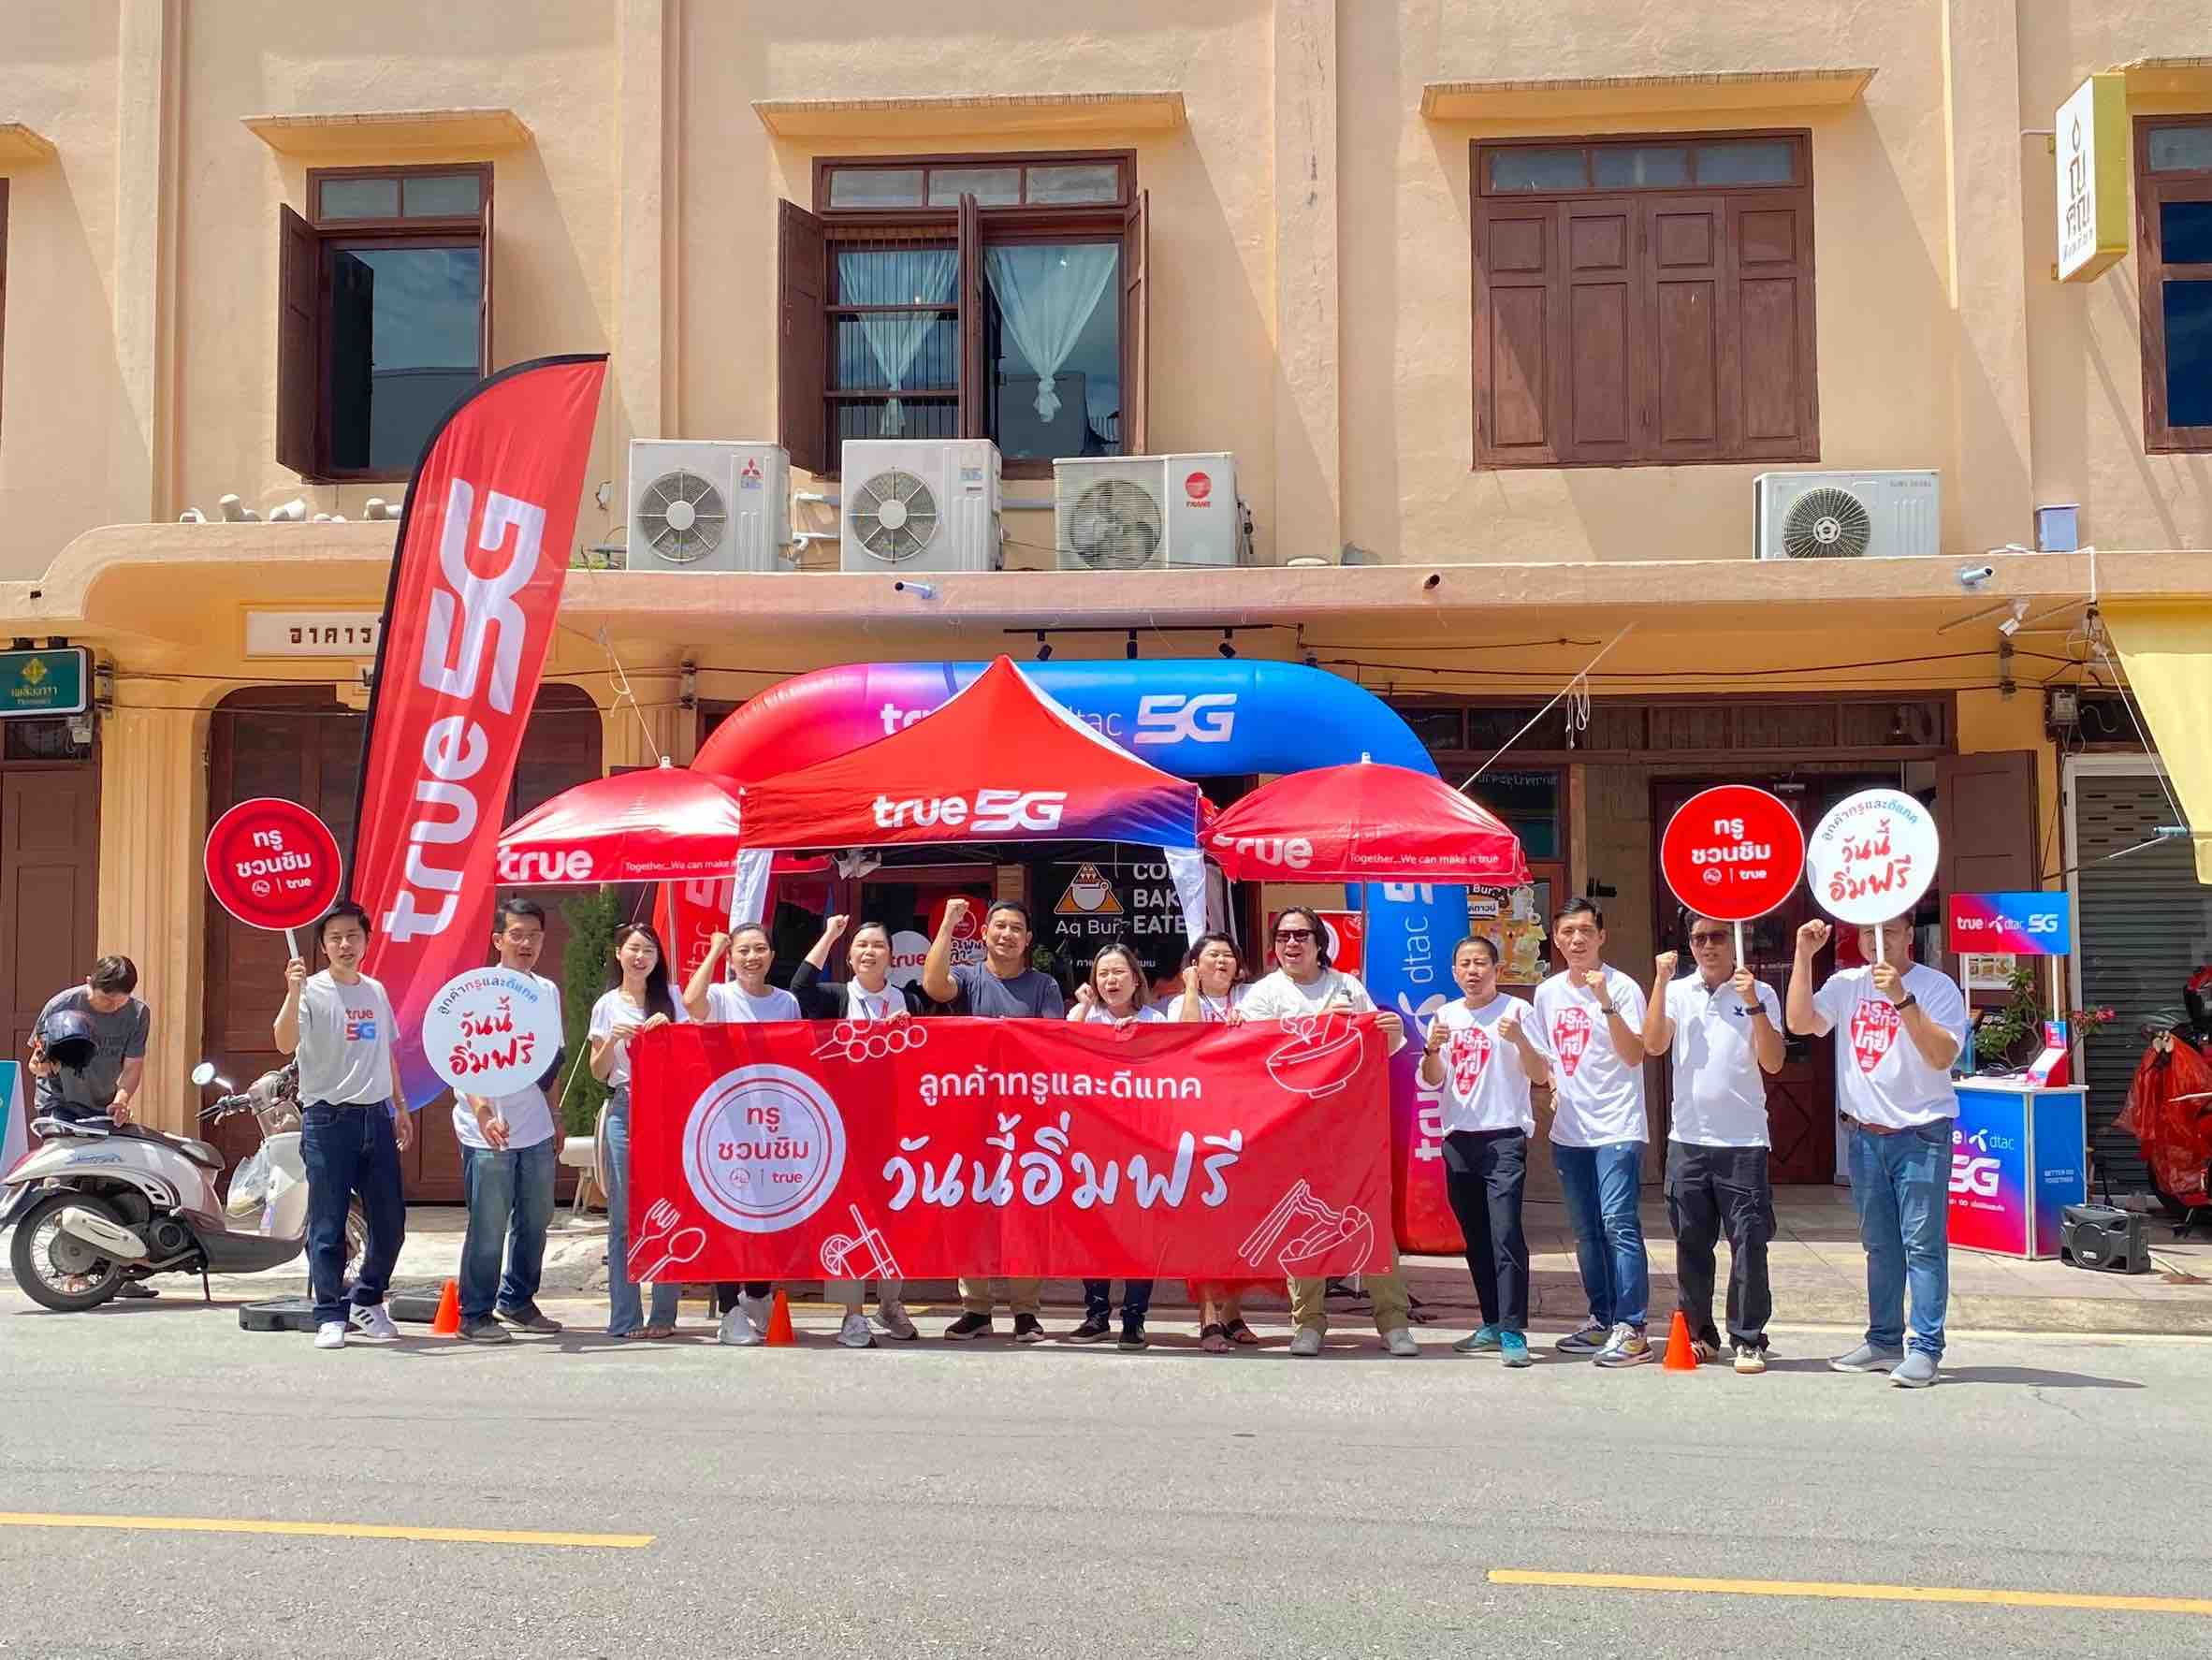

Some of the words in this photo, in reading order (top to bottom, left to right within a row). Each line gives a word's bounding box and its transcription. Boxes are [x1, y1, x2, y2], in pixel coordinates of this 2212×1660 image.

[419, 478, 546, 716] 5G
[880, 703, 936, 735] tr
[1133, 693, 1238, 744] 5G
[872, 794, 968, 828] true
[970, 789, 1068, 831] 5G
[253, 829, 284, 852] ทรู
[383, 715, 488, 943] true
[1713, 818, 1745, 840] ทรู
[1841, 817, 1893, 863] วันนี้
[236, 851, 312, 878] ชวนชิม
[497, 846, 593, 881] true
[1213, 833, 1315, 869] rue
[1692, 841, 1771, 865] ชวนชิม
[285, 877, 312, 889] true
[1133, 864, 1171, 880] CO
[1739, 868, 1768, 881] true
[1828, 853, 1913, 902] อิ่มฟรี
[1133, 889, 1180, 908] BAK
[1133, 915, 1187, 934] EATE
[1957, 916, 1984, 930] true
[2028, 913, 2059, 933] 5G
[1401, 914, 1434, 983] dtac
[345, 1008, 374, 1019] true
[459, 995, 514, 1039] วันนี้
[346, 1022, 376, 1041] 5G
[448, 1031, 535, 1076] อิ่มฟรี
[919, 1065, 1203, 1106] ลูกค้าทรูและดีแทค
[746, 1106, 780, 1133] ทรู
[1414, 1090, 1446, 1161] tru
[718, 1137, 809, 1160] ชวนชิม
[1989, 1135, 2015, 1150] dtac
[882, 1111, 1244, 1212] วันนี้อิ่มฟรี
[771, 1169, 803, 1184] true
[1948, 1154, 2001, 1198] 5G
